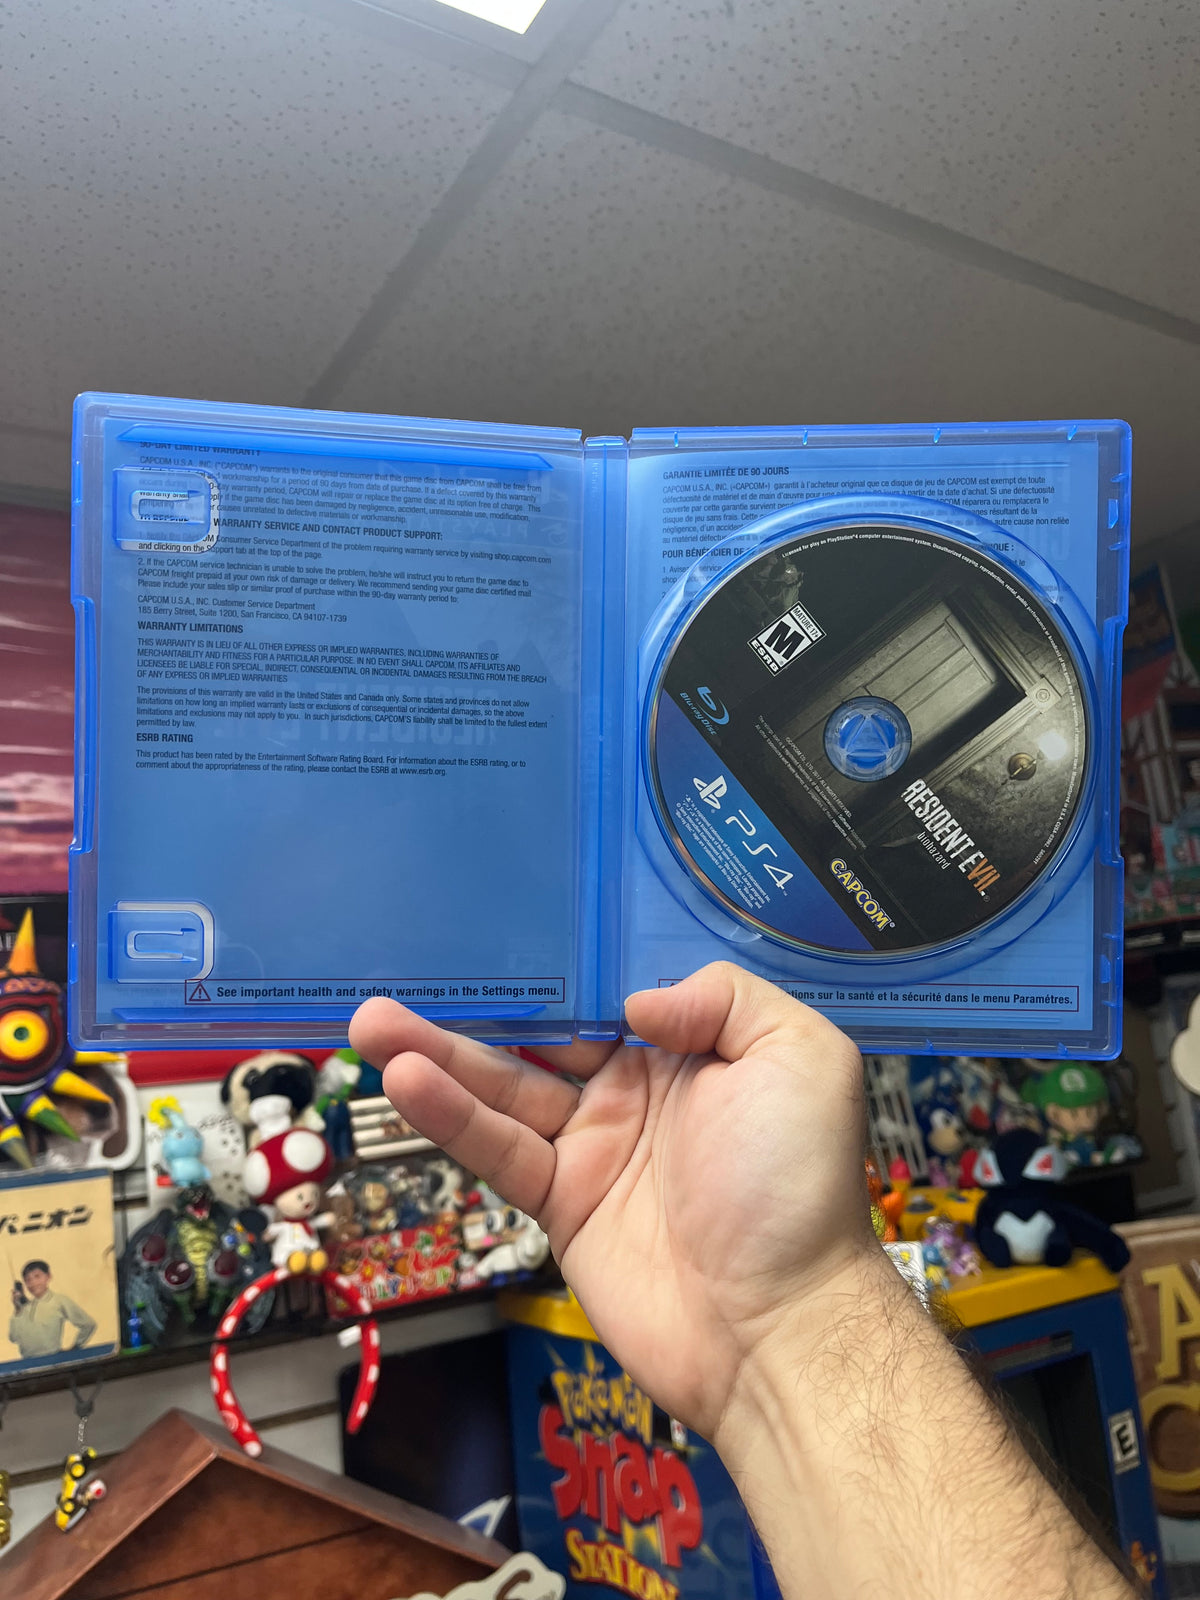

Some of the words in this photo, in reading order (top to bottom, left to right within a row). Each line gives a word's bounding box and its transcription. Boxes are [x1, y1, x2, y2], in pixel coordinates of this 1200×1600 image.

[663, 469, 702, 480] GARANTIE
[703, 468, 736, 479] LIMITÉE
[737, 467, 749, 478] DE
[750, 467, 761, 477] 90
[761, 466, 789, 477] JOURS
[663, 483, 691, 493] CAPCOM
[773, 481, 799, 493] garantit
[806, 480, 839, 490] l'acheteur
[840, 479, 865, 491] original
[866, 481, 880, 491] que
[890, 478, 913, 490] disque
[924, 480, 935, 489] jeu
[946, 477, 977, 486] CAPCOM
[978, 477, 989, 486] est
[990, 476, 1016, 488] exempt
[1027, 475, 1045, 485] toute
[213, 518, 261, 530] WARRANTY
[264, 521, 300, 533] SERVICE
[301, 523, 320, 534] AND
[322, 524, 360, 536] CONTACT
[362, 527, 401, 539] PRODUCT
[403, 529, 442, 541] SUPPORT:
[138, 542, 152, 551] and
[152, 543, 181, 554] clicking
[192, 545, 205, 553] the
[235, 547, 246, 555] tab
[248, 547, 255, 556] at
[257, 548, 268, 556] the
[270, 548, 281, 559] top
[282, 549, 290, 557] of
[291, 549, 302, 558] the
[304, 552, 321, 561] page.
[138, 595, 169, 604] CAPCOM
[211, 598, 245, 607] Customer
[247, 599, 273, 608] Service
[274, 600, 315, 612] Department
[138, 606, 151, 615] 185
[153, 607, 172, 617] Berry
[198, 608, 217, 617] Suite
[240, 610, 254, 619] San
[292, 612, 304, 621] CA
[303, 613, 347, 622] 94107-1739
[793, 607, 811, 630] MATURE
[138, 621, 187, 631] WARRANTY
[189, 623, 243, 633] LIMITATIONS
[764, 620, 805, 660] M
[136, 732, 159, 742] ESRB
[161, 733, 193, 743] RATING
[136, 750, 150, 758] This
[152, 750, 179, 761] product
[180, 751, 194, 759] has
[195, 751, 212, 759] been
[214, 752, 233, 760] rated
[234, 752, 243, 762] by
[244, 752, 256, 761] the
[257, 753, 306, 762] Entertainment
[307, 754, 338, 763] Software
[339, 755, 361, 765] Rating
[362, 755, 384, 764] Board.
[386, 756, 396, 764] For
[398, 756, 436, 765] information
[437, 757, 456, 766] about
[457, 758, 468, 766] the
[469, 758, 488, 767] ESRB
[489, 759, 508, 769] rating,
[519, 759, 526, 767] to
[136, 760, 169, 769] comment
[170, 761, 190, 770] about
[192, 762, 203, 770] the
[205, 762, 261, 773] appropriateness
[262, 763, 269, 771] of
[271, 764, 282, 772] the
[283, 764, 305, 774] rating,
[307, 764, 330, 775] please
[330, 765, 357, 773] contact
[357, 765, 369, 774] the
[370, 766, 389, 774] ESRB
[390, 766, 398, 774] at
[399, 766, 446, 777] www.esrb.org.
[901, 778, 975, 859] RESIDENT
[725, 809, 794, 890] PS4
[916, 831, 951, 870] biohazard
[829, 857, 892, 932] CAPCOM
[217, 986, 238, 997] See
[240, 986, 294, 1000] important
[297, 986, 332, 997] health
[334, 986, 356, 997] and
[358, 986, 392, 1000] safety
[395, 988, 445, 999] warnings
[447, 988, 458, 997] in
[460, 986, 478, 997] the
[480, 986, 524, 999] Settings
[527, 988, 559, 997] menu.
[786, 990, 815, 1001] tions
[817, 992, 832, 1001] sur
[836, 990, 845, 1001] la
[847, 990, 874, 1001] santé
[877, 990, 887, 1001] et
[889, 991, 899, 1002] la
[902, 991, 941, 1002] sécurité
[944, 991, 968, 1003] dans
[971, 992, 980, 1003] le
[982, 994, 1010, 1003] menu
